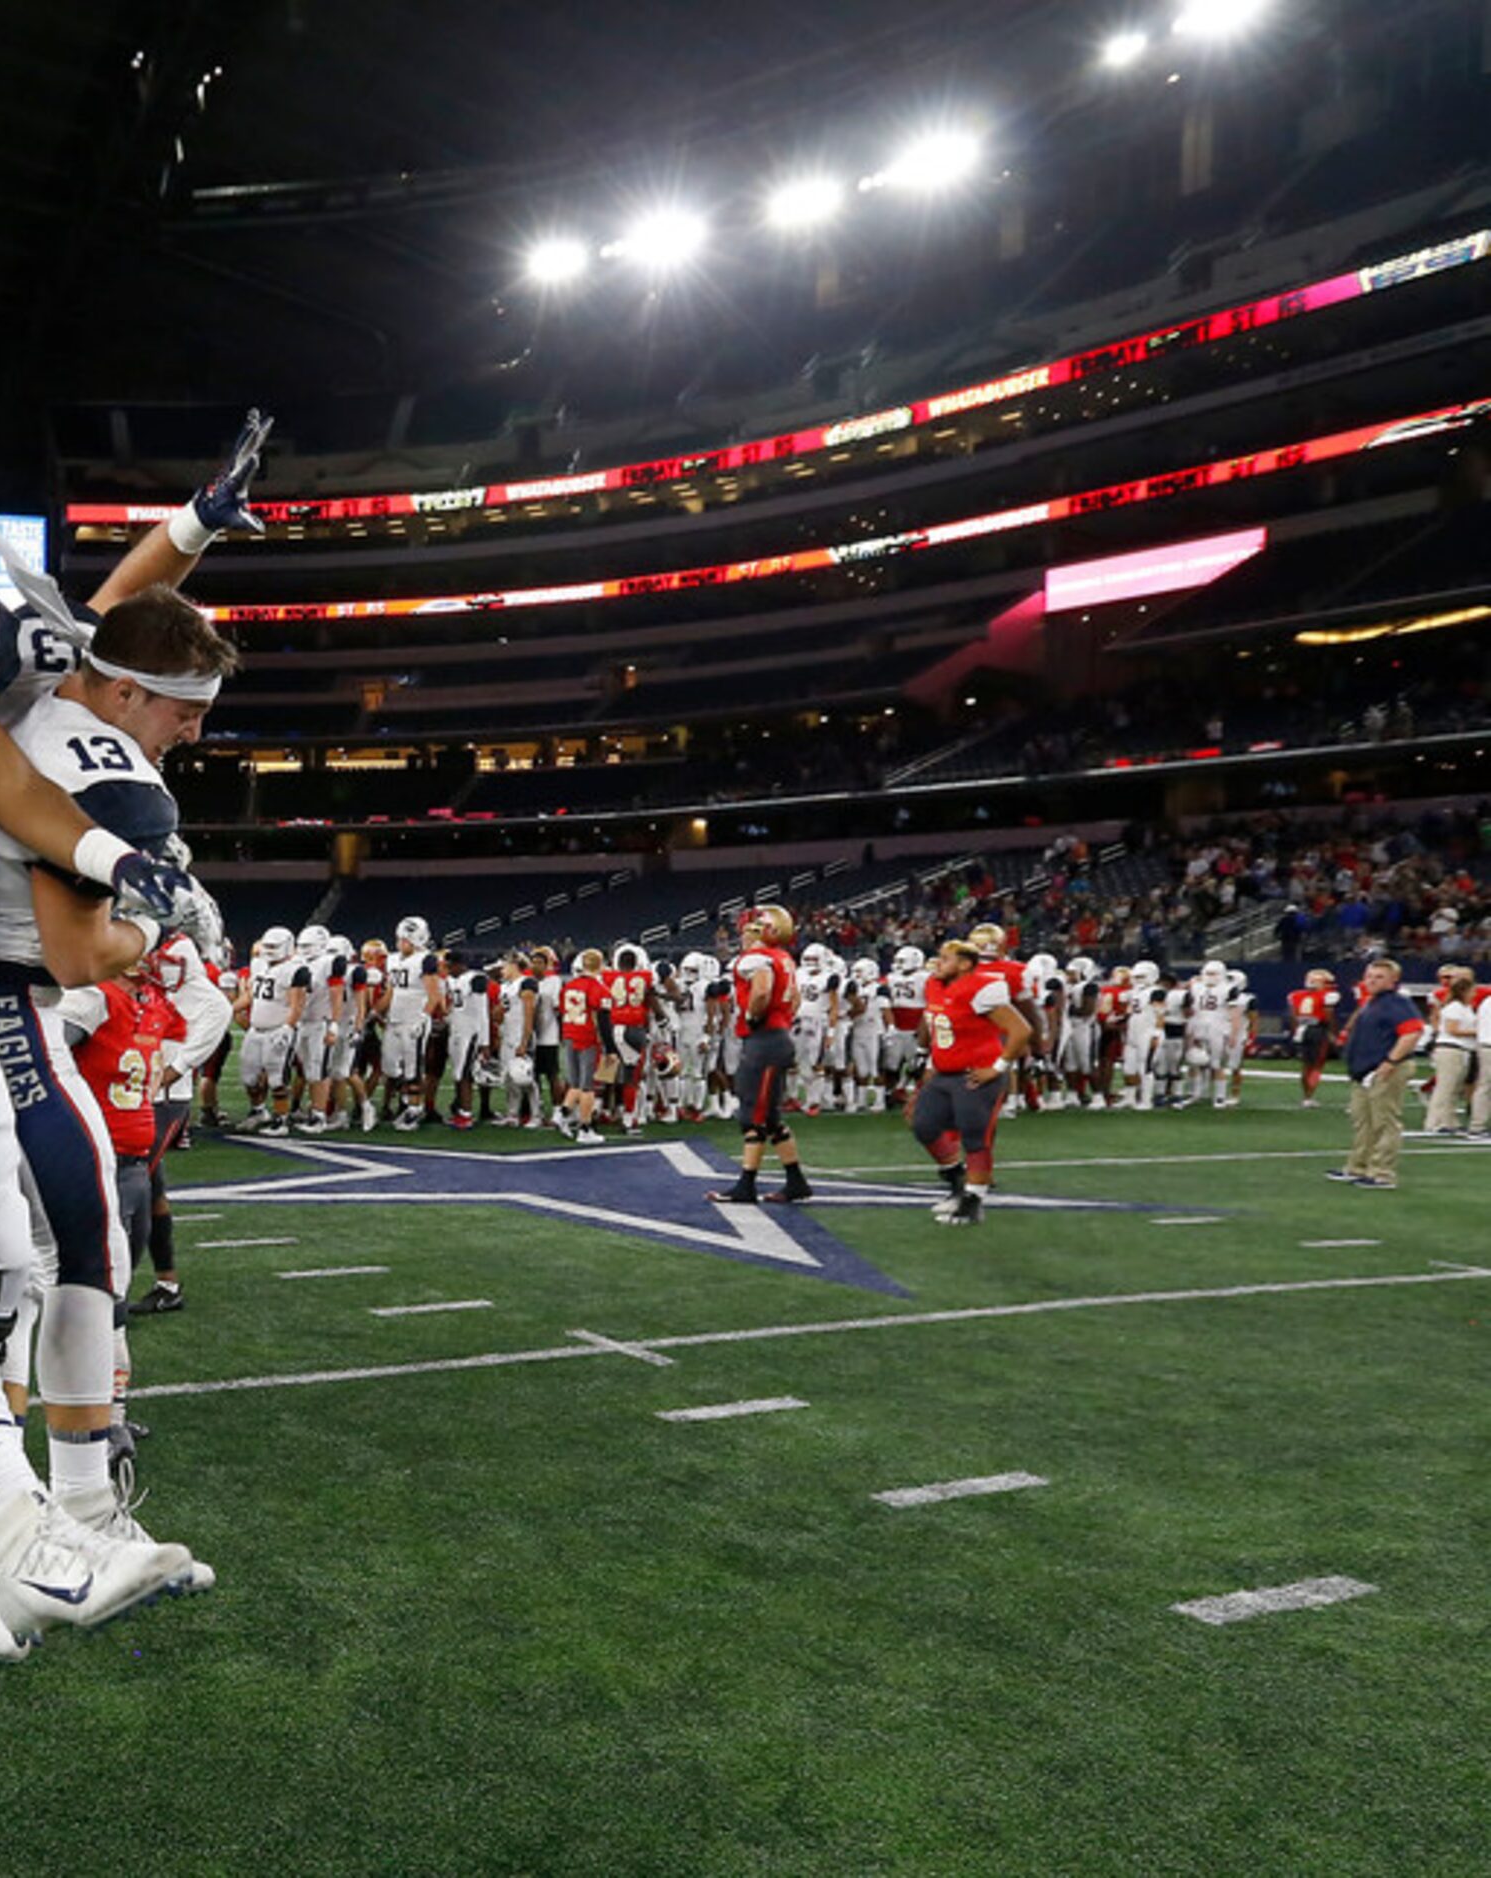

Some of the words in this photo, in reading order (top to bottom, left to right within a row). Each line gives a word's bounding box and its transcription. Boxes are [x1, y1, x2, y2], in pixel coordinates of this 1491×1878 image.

[66, 735, 135, 773] 13
[253, 975, 276, 1001] 73
[610, 975, 646, 1008] 43
